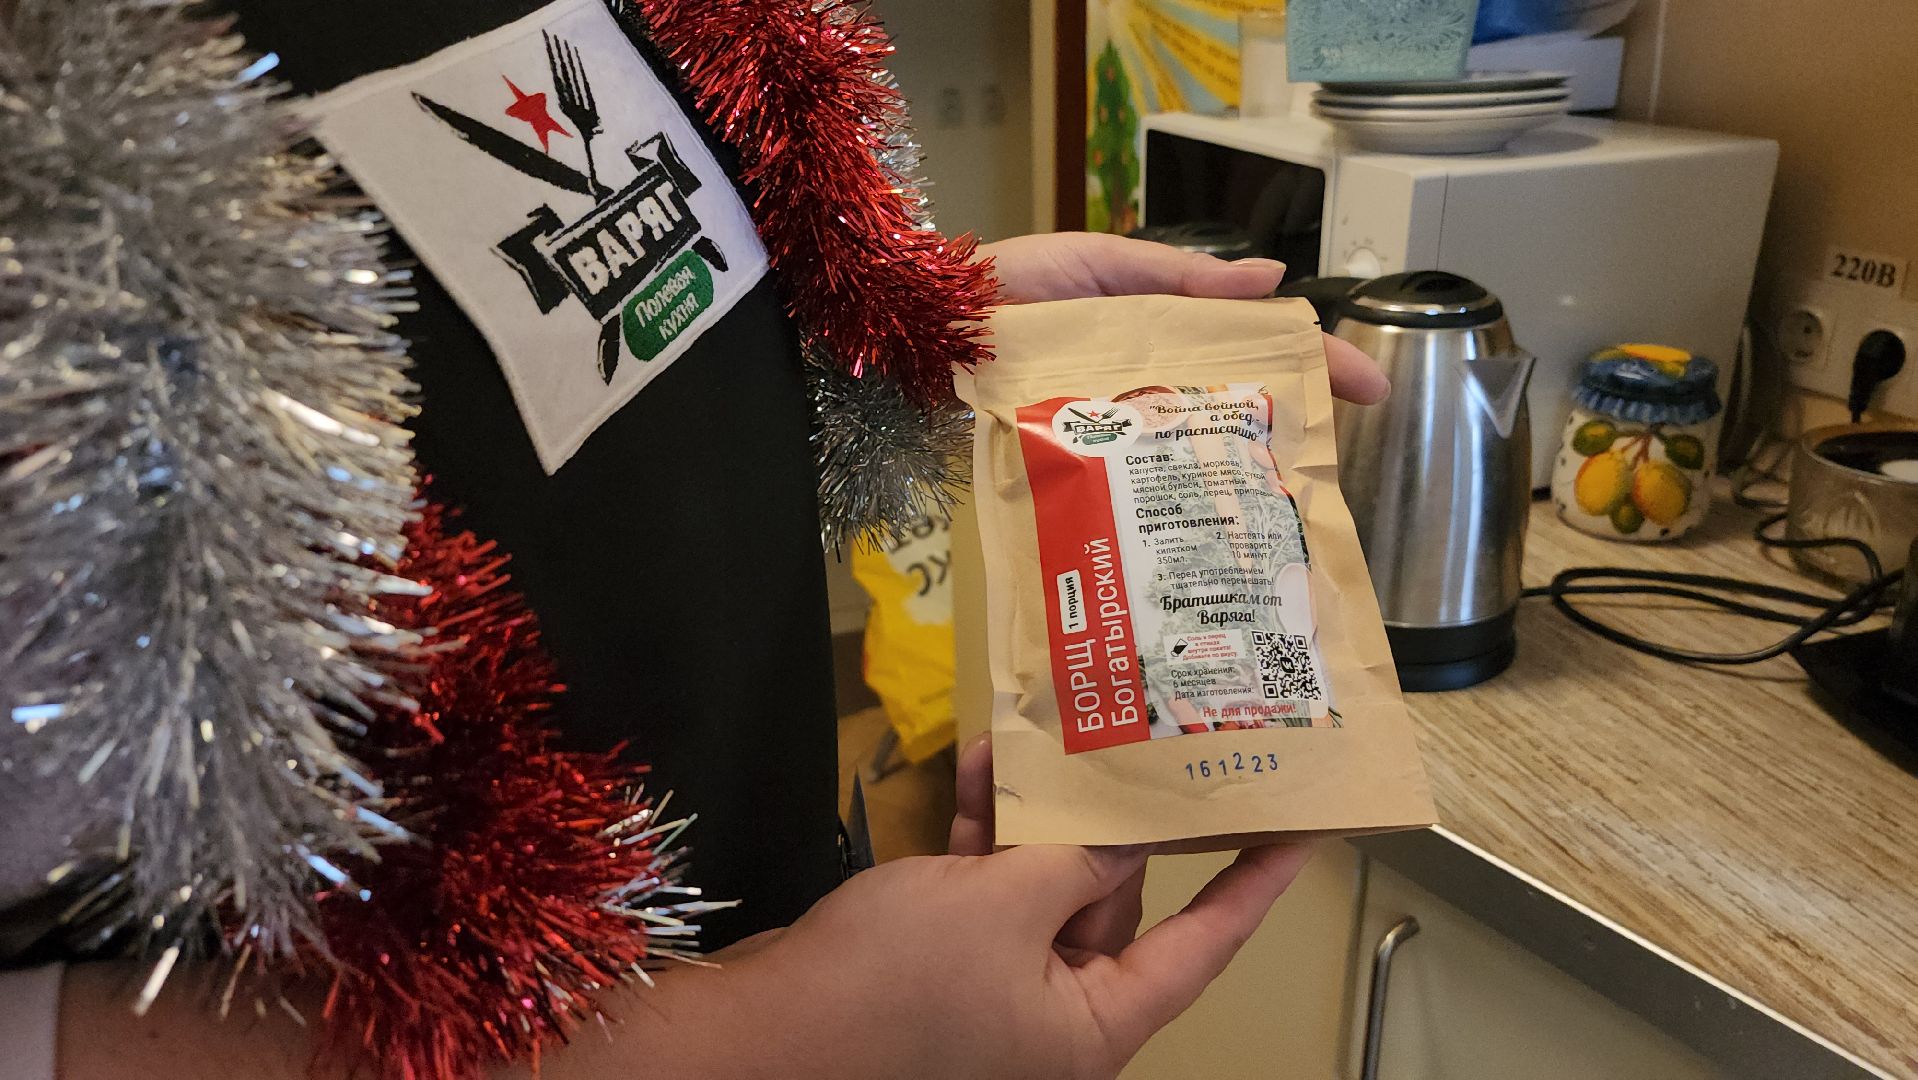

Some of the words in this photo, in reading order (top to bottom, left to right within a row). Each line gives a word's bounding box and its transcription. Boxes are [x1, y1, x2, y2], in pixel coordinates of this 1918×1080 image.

[567, 180, 682, 296] ВАРЯГ
[1830, 252, 1896, 288] 220В
[634, 265, 697, 328] Полевая
[658, 292, 700, 340] кухня
[1204, 399, 1259, 412] войной,
[1155, 430, 1173, 439] по
[1125, 453, 1174, 466] Состав:
[1129, 466, 1166, 476] капуста,
[1168, 462, 1201, 472] свекла,
[1203, 460, 1242, 469] морковь,
[1131, 474, 1180, 486] картофель,
[1182, 470, 1218, 480] куриное
[1220, 468, 1243, 477] мясо,
[1133, 484, 1166, 494] мясной
[1203, 477, 1247, 488] томатный
[1134, 494, 1176, 505] порошок,
[1136, 503, 1183, 519] Способ
[1138, 515, 1239, 536] приготовления:
[1142, 539, 1151, 548] 1.
[1154, 537, 1184, 546] Залить
[1227, 531, 1266, 540] Настоять
[1267, 531, 1283, 540] или
[1156, 545, 1197, 555] кипятком
[1229, 542, 1273, 551] проварить
[1232, 551, 1241, 559] 10
[1168, 570, 1198, 581] Перед
[1198, 567, 1264, 579] употреблением
[1170, 577, 1219, 590] тщательно
[1221, 575, 1275, 587] перемешать!
[1065, 576, 1078, 619] порция
[1160, 592, 1260, 613] Братишкам
[1262, 594, 1283, 607] от
[1197, 609, 1256, 627] Варяга!
[1068, 622, 1079, 630] 1
[1084, 537, 1139, 727] Богатырский
[1171, 669, 1192, 679] Срок
[1193, 666, 1236, 677] хранения:
[1064, 638, 1105, 733] БОРЩ
[1173, 680, 1179, 688] 6
[1180, 678, 1217, 688] месяцев
[1175, 690, 1195, 701] Дата
[1196, 686, 1255, 698] изготовления:
[1203, 707, 1217, 718] Не
[1221, 706, 1242, 719] для
[1244, 704, 1297, 718] продажи!
